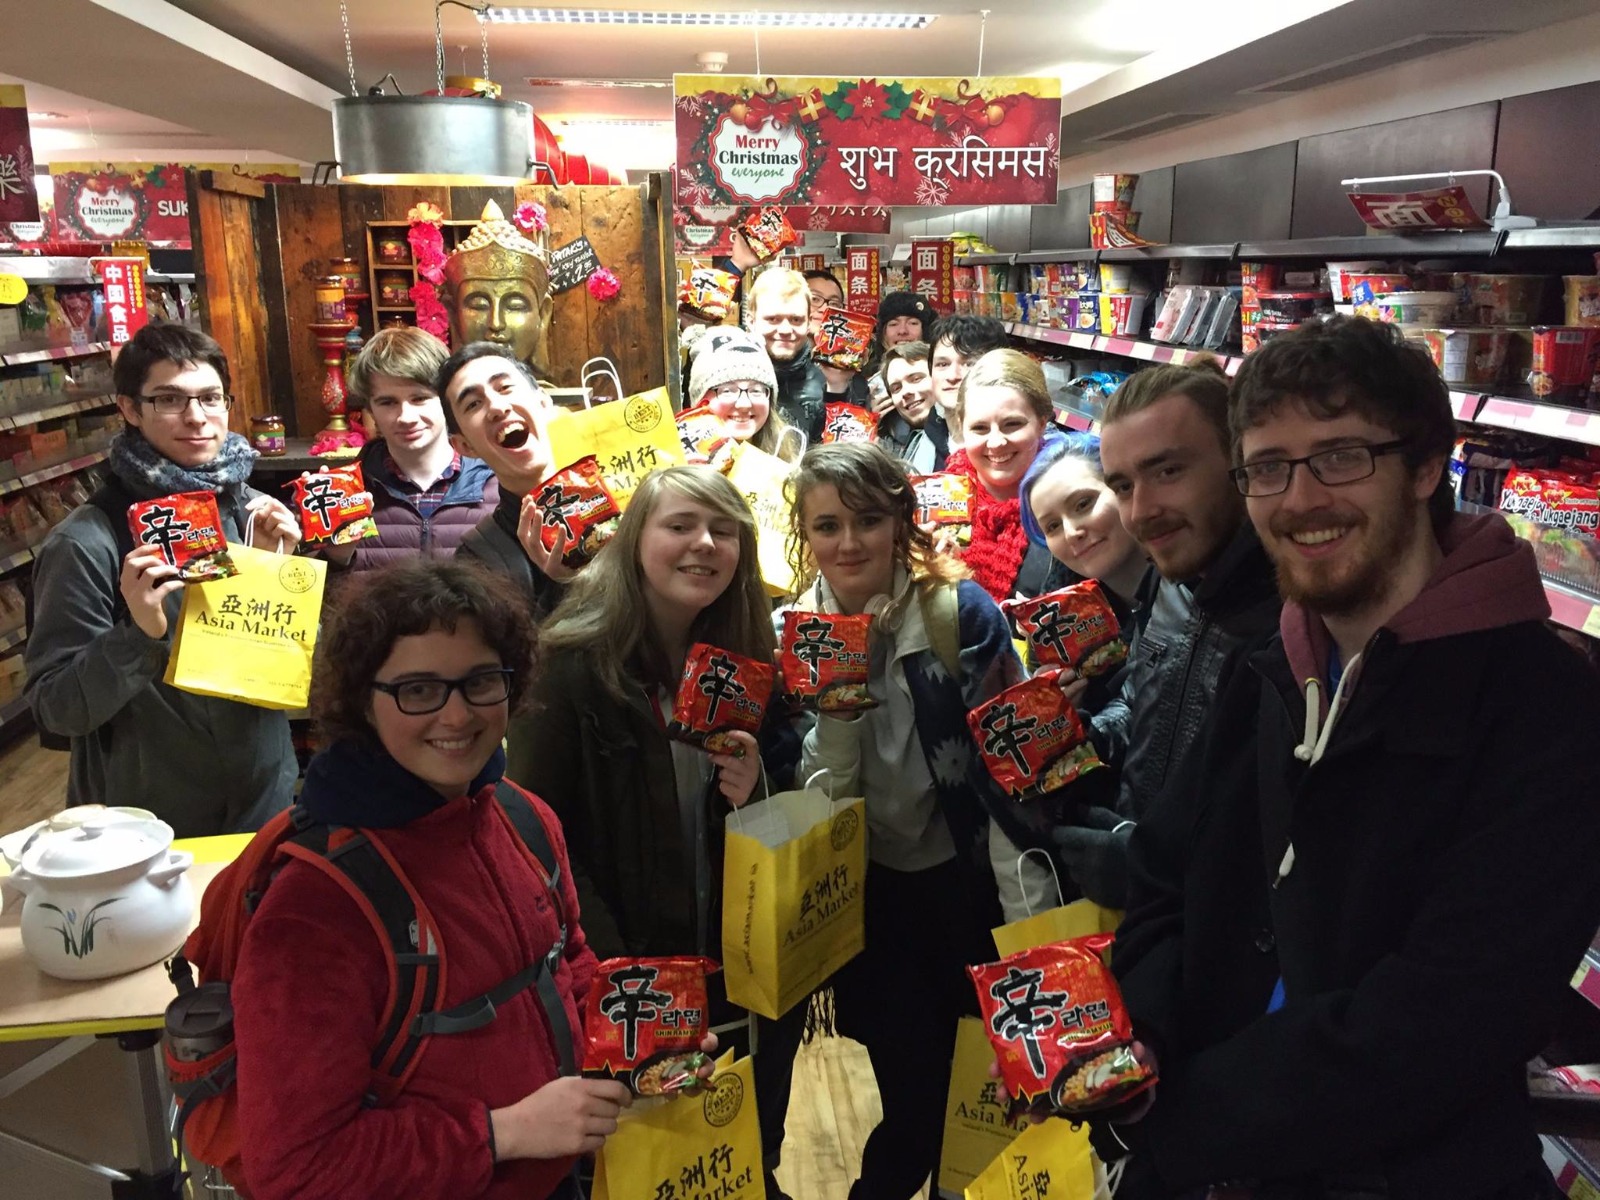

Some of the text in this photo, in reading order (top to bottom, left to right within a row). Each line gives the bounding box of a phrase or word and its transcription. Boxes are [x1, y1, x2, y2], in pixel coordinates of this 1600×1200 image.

[719, 149, 799, 165] Christmas
[735, 135, 780, 152] Merry
[732, 167, 785, 183] everyone
[838, 146, 897, 189] शुभ
[82, 206, 133, 216] Christmas
[91, 198, 120, 207] Merry
[851, 252, 868, 295] 面条
[303, 479, 344, 529] 辛
[1540, 508, 1599, 528] Yukgaejang
[140, 506, 190, 566] 辛
[195, 611, 235, 631] Asia
[241, 618, 307, 641] Market
[218, 594, 297, 625] 亞洲行
[1029, 602, 1078, 664] 辛
[792, 617, 845, 687] 辛
[698, 654, 746, 725] 辛
[980, 702, 1038, 778] 辛
[783, 882, 860, 947] Asia Market
[600, 965, 672, 1060] 辛
[661, 1008, 701, 1028] 라면
[990, 967, 1069, 1079] 辛
[1060, 1001, 1110, 1028] 라면
[955, 1102, 994, 1124] Asia
